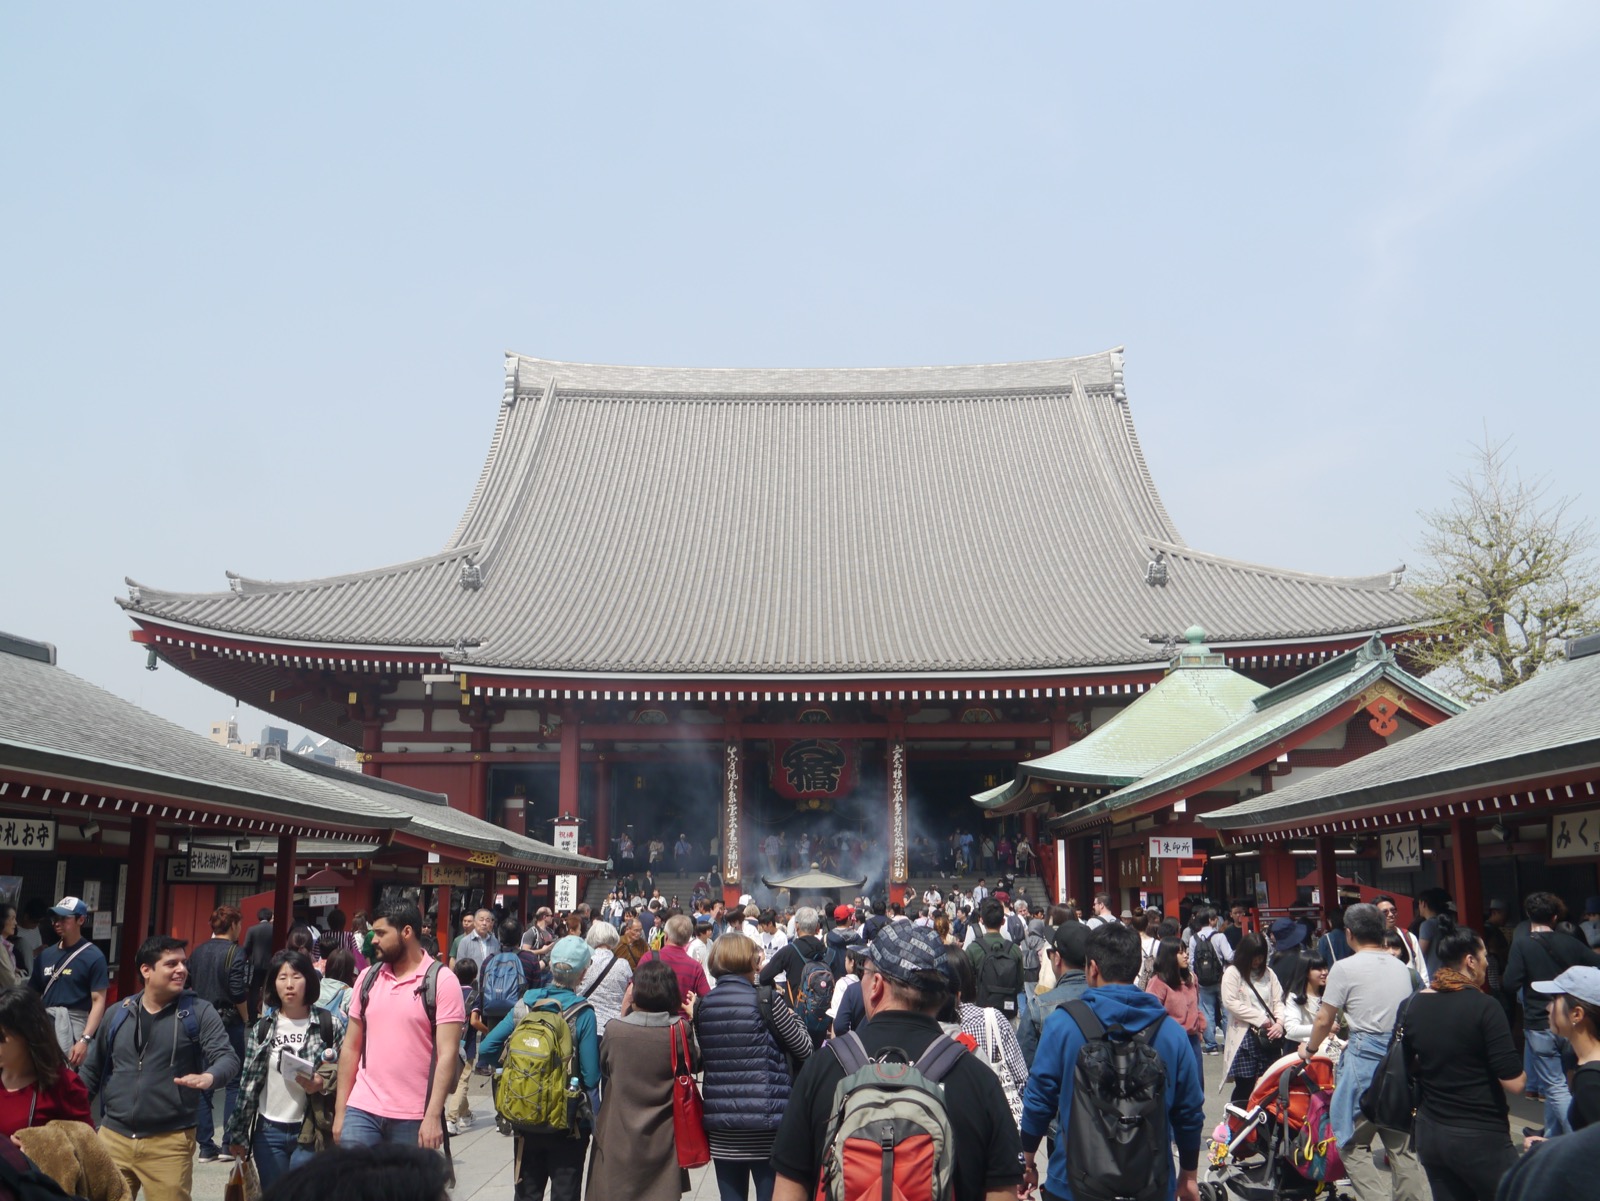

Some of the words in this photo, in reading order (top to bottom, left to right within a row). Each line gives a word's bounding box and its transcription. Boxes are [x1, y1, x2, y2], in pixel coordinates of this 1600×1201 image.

[0, 821, 49, 848] 札お守
[1163, 841, 1191, 854] 朱印所
[1385, 836, 1417, 862] みくじ
